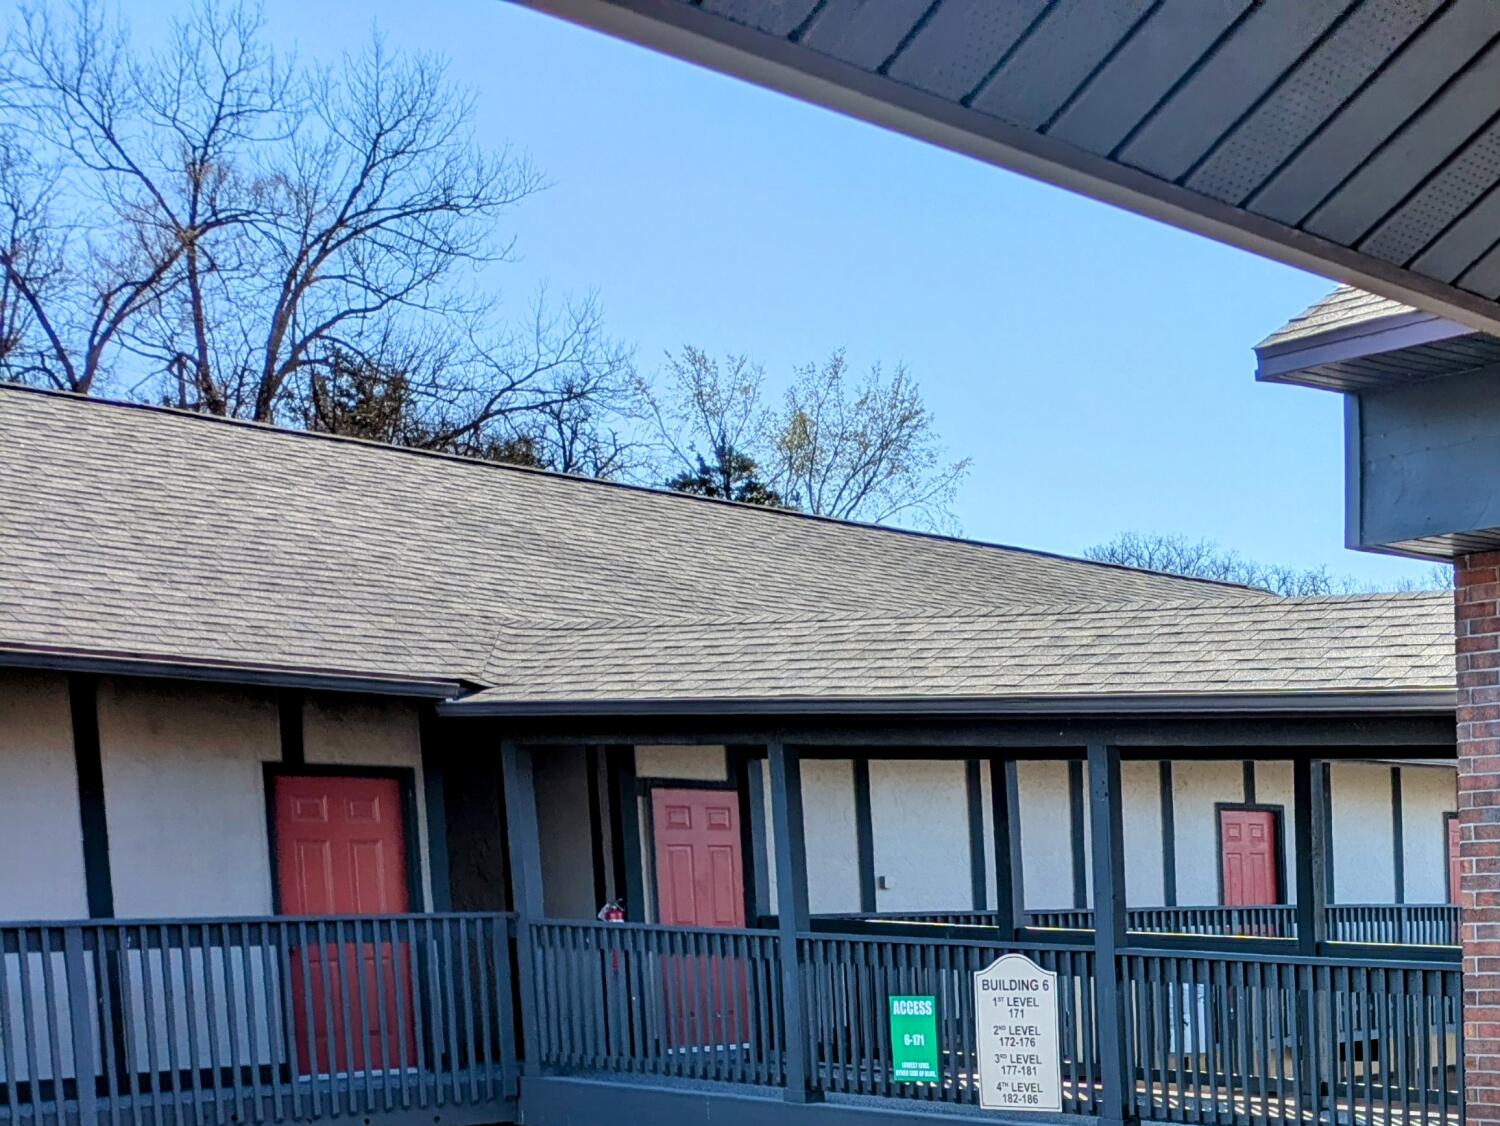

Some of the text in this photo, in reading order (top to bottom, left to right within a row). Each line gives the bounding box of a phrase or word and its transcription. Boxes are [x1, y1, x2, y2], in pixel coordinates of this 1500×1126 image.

[982, 978, 1050, 991] BUILDING 6
[1006, 997, 1039, 1007] LEVEL
[893, 1000, 932, 1016] ACCESS
[1009, 1008, 1025, 1018] 171
[1009, 1025, 1041, 1036] LEVEL
[903, 1033, 925, 1046] 6-171
[999, 1037, 1036, 1047] 172-176
[1010, 1054, 1042, 1064] LEVEL
[1001, 1065, 1037, 1076] 177-181
[1011, 1082, 1044, 1093] LEVEL
[1002, 1094, 1039, 1104] 182-186
